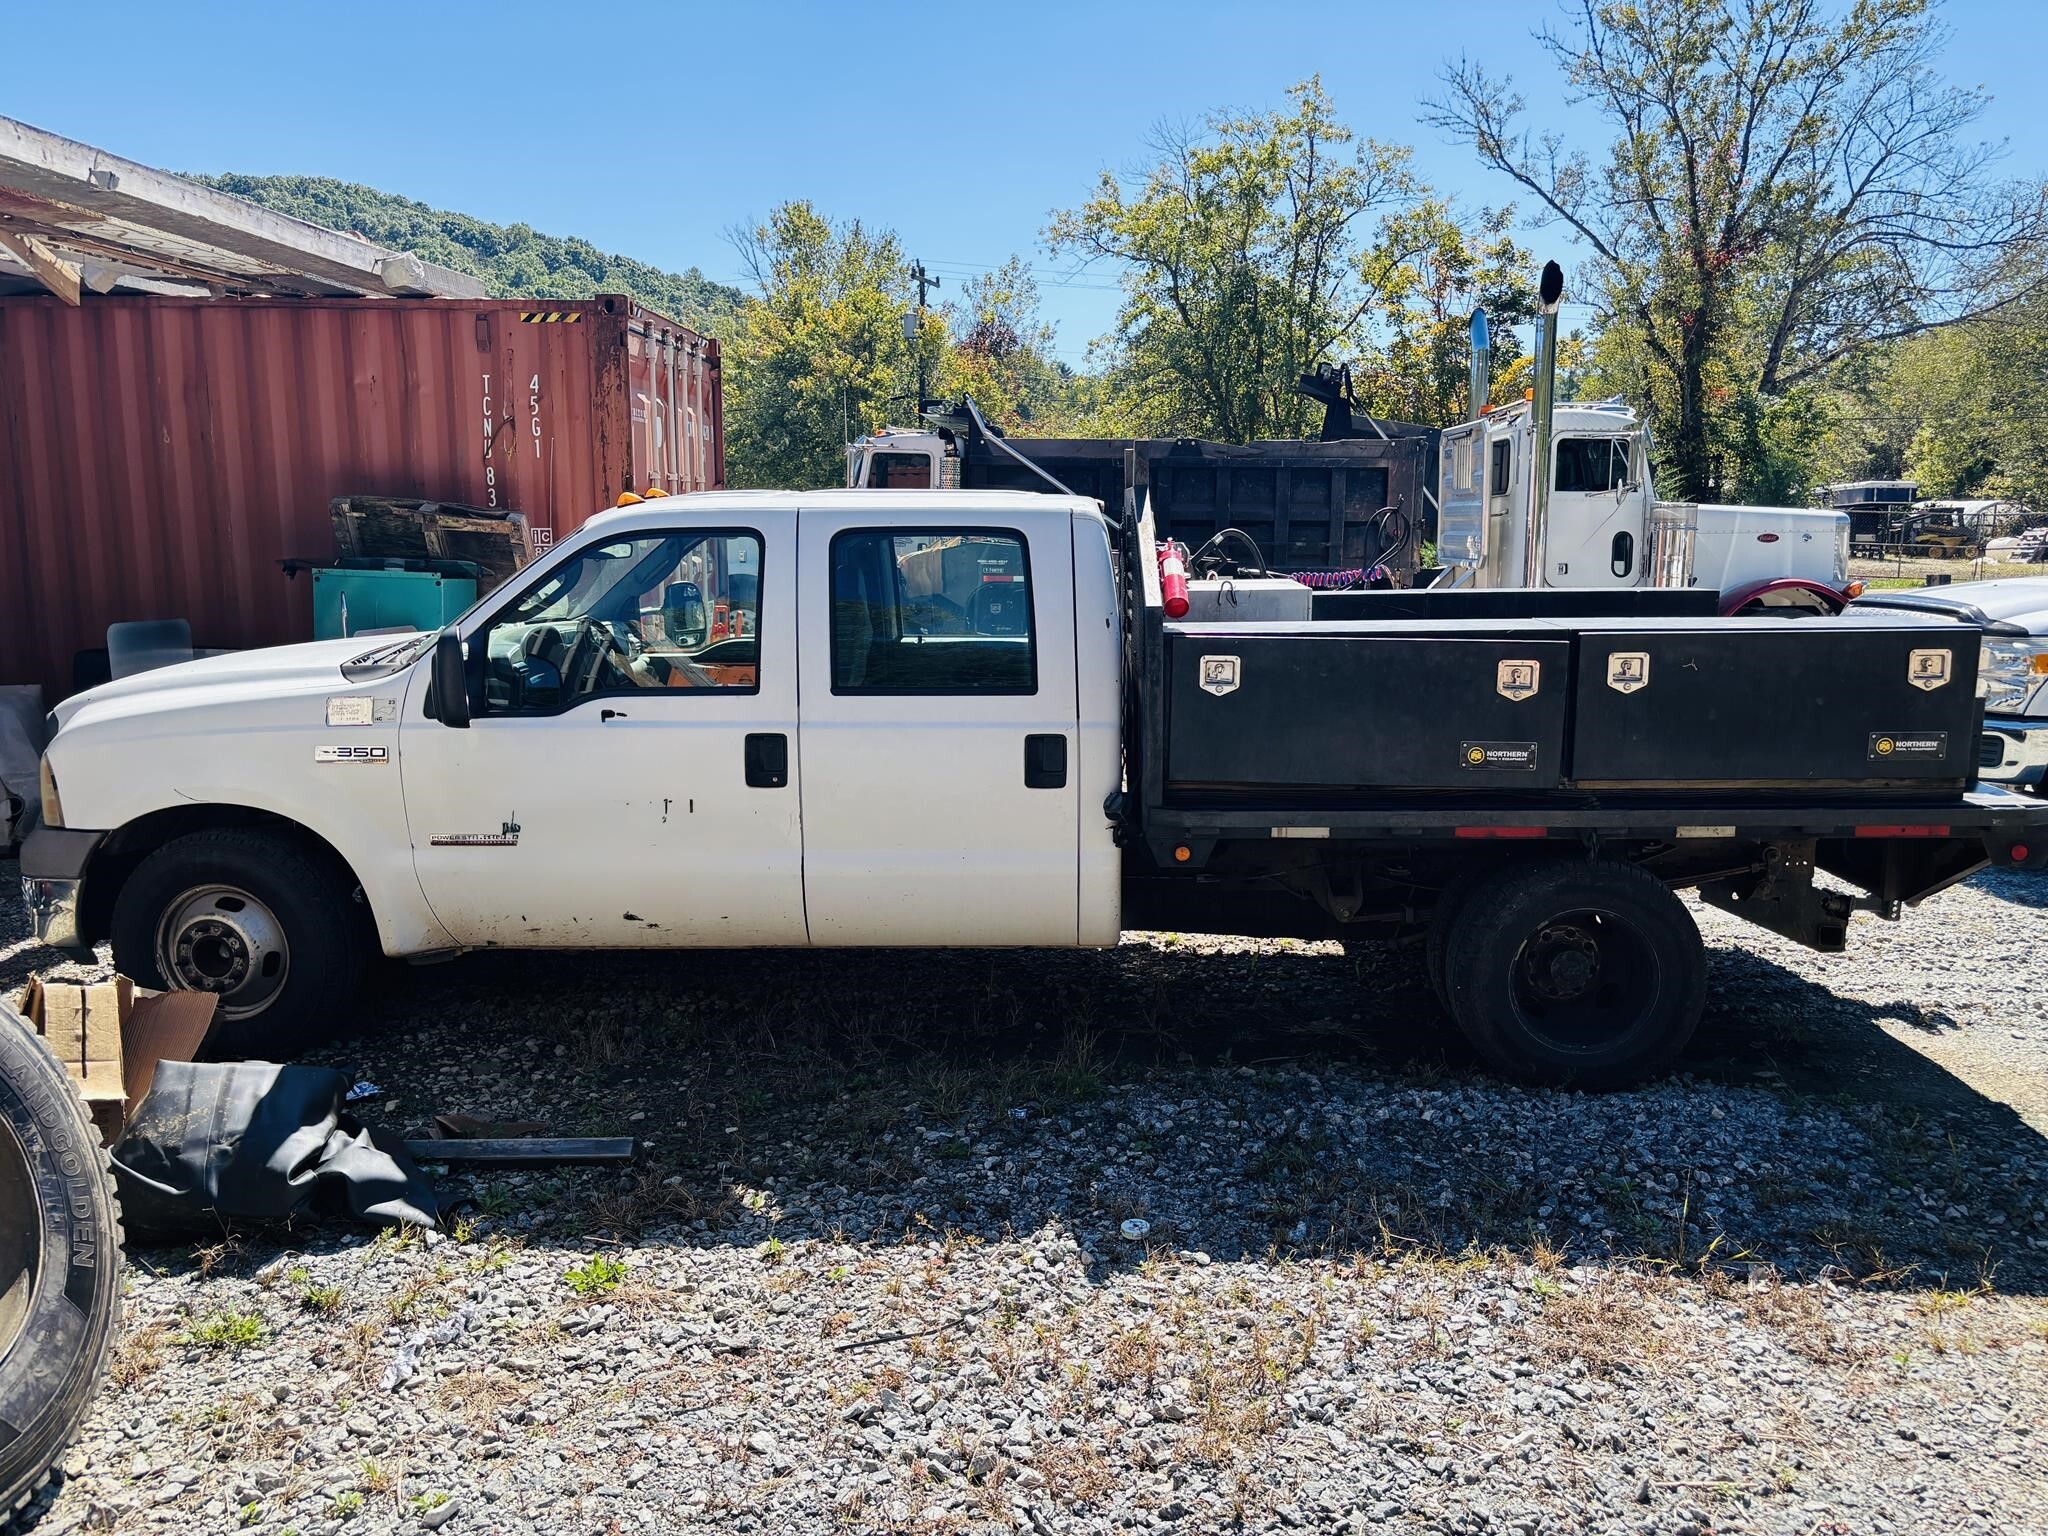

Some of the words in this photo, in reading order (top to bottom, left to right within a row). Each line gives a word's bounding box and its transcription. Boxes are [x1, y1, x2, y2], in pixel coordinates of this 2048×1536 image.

[529, 374, 541, 459] 45G1
[1486, 750, 1529, 758] NORTHERN
[0, 1044, 96, 1268] LANDGOLDEN
